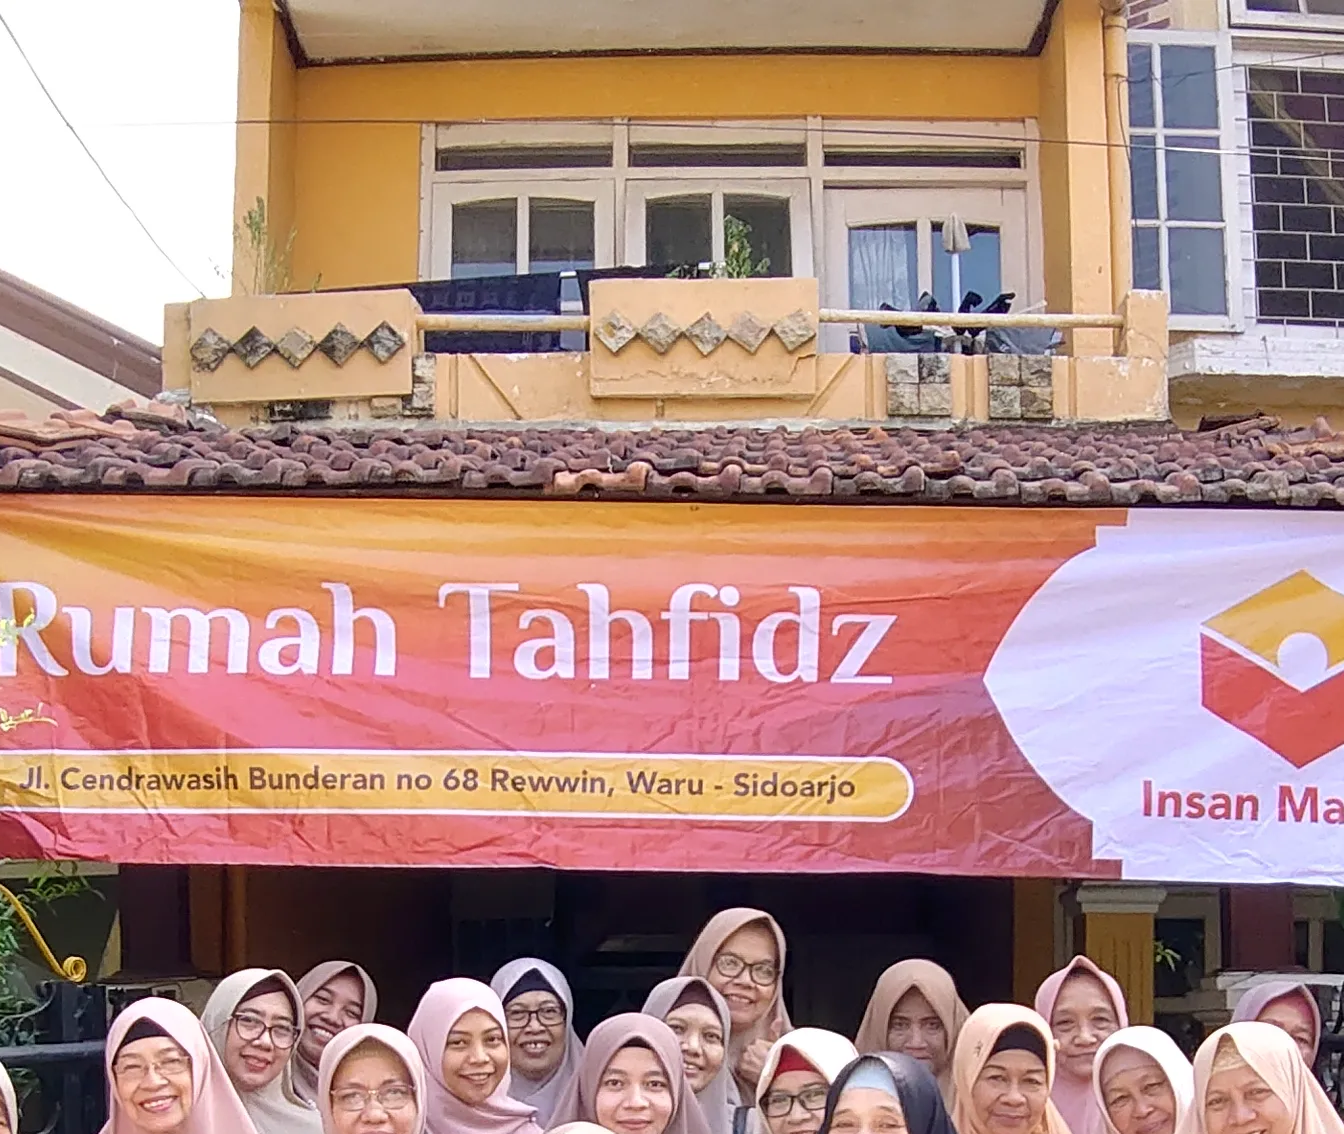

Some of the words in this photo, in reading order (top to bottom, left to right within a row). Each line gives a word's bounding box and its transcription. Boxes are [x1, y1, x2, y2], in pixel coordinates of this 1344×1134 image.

[438, 581, 899, 687] Tahfidz
[19, 766, 50, 791] Jl.
[60, 765, 238, 792] Cendrawasih
[249, 765, 385, 792] Bunderan
[396, 772, 433, 791] no
[443, 768, 478, 792] 68
[490, 769, 615, 797] Rewwin,
[627, 771, 704, 796] Waru
[733, 771, 856, 804] Sidoarjo
[1142, 780, 1260, 822] Insan
